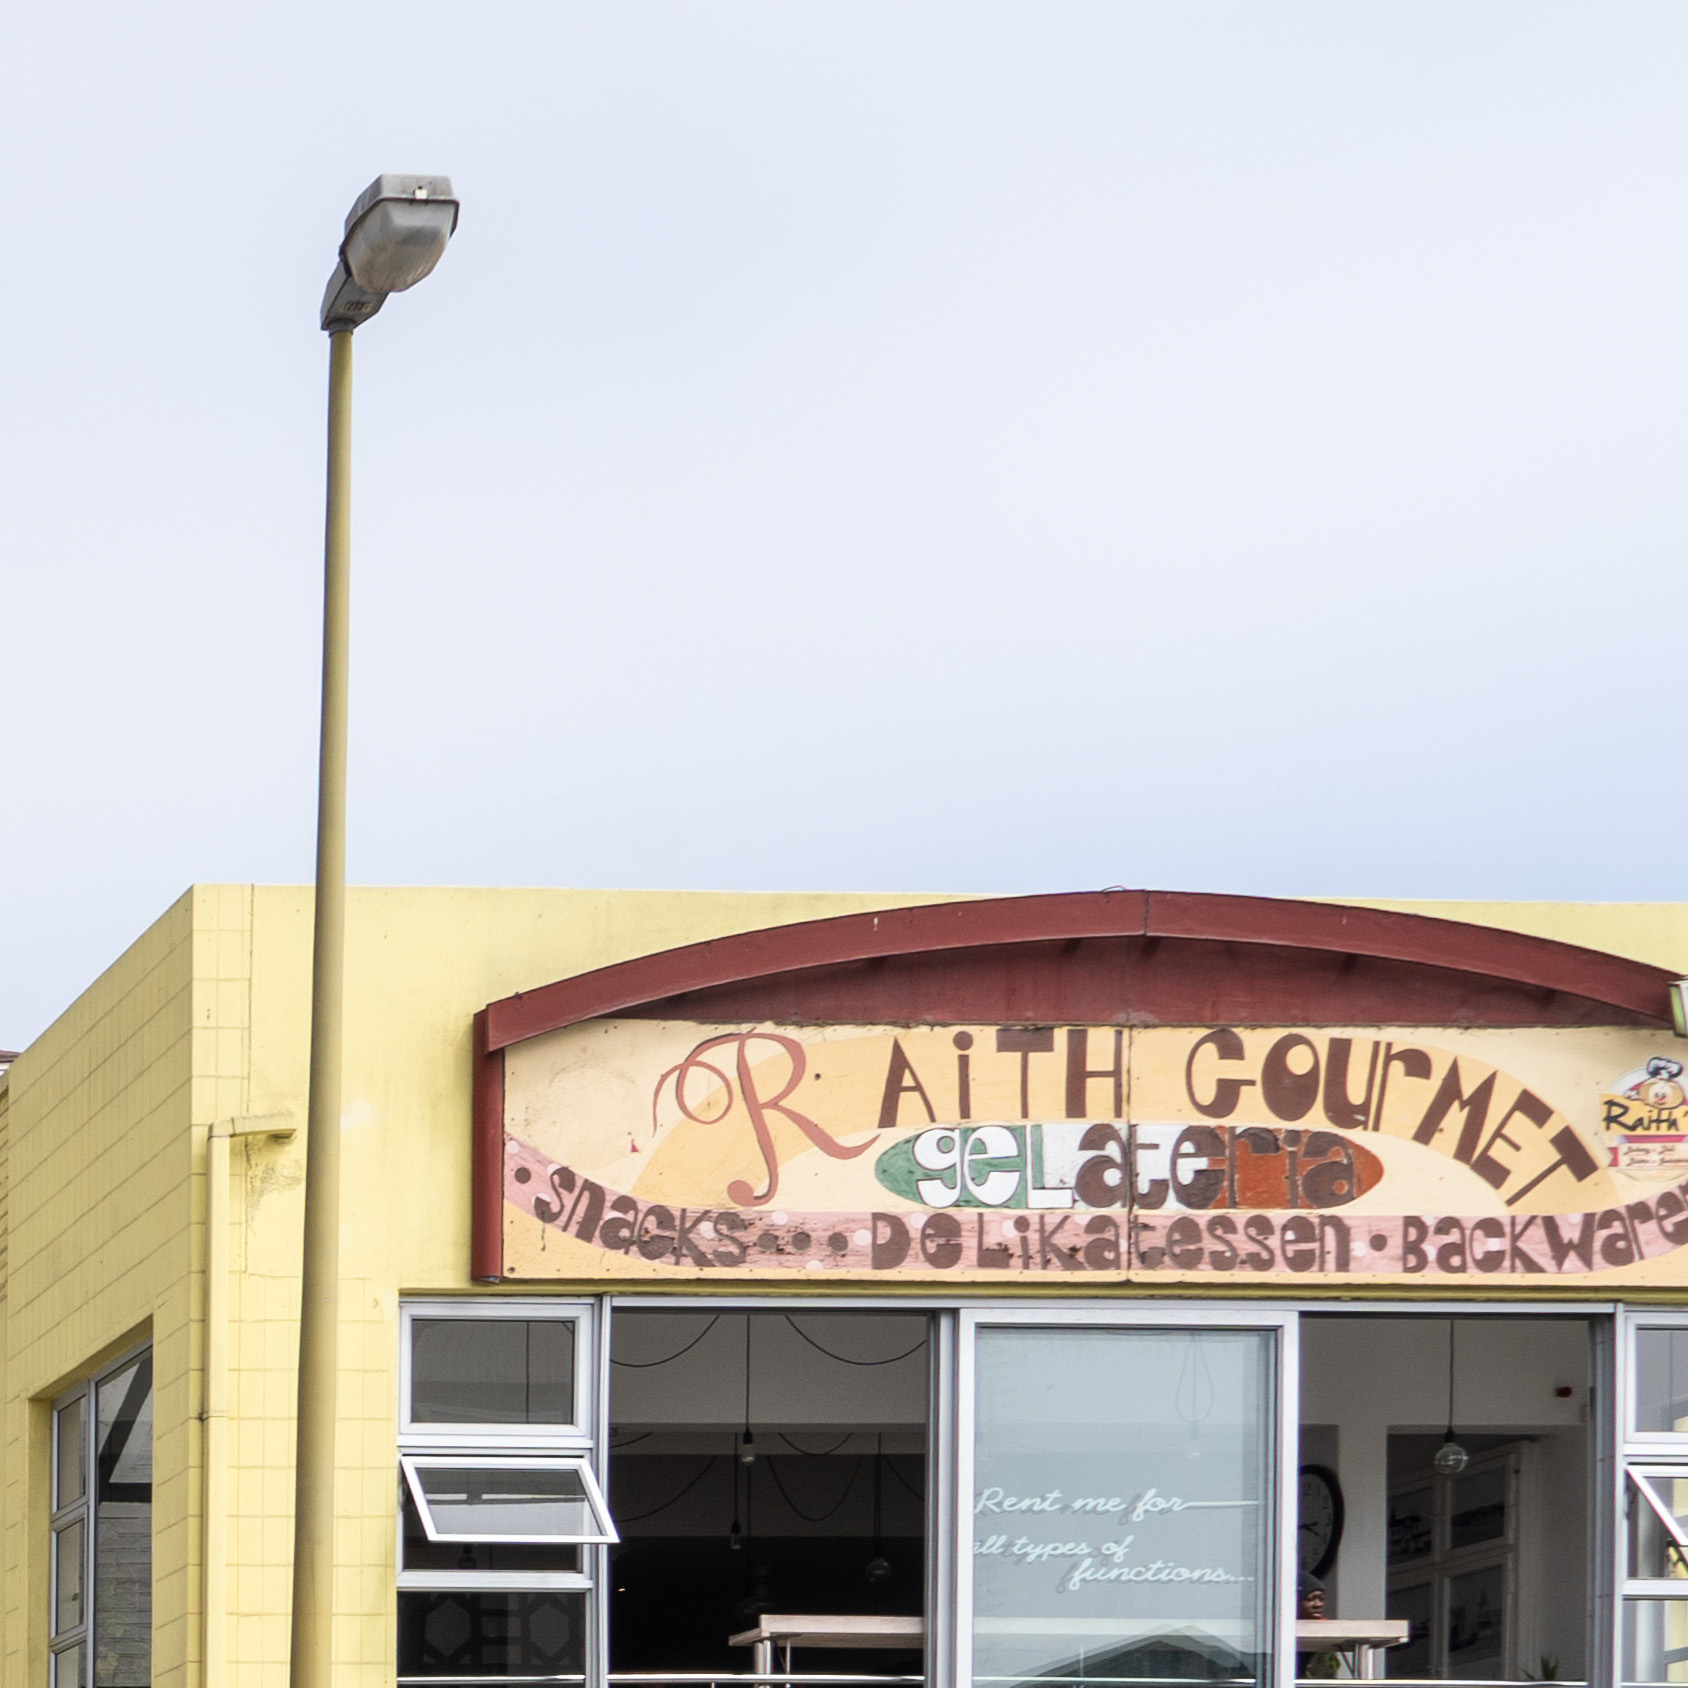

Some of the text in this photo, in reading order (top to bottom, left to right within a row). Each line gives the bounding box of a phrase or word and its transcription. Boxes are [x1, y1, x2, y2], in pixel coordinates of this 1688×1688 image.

[974, 1487, 1062, 1513] Rent
[1073, 1496, 1127, 1512] me
[973, 1535, 1135, 1562] all types of
